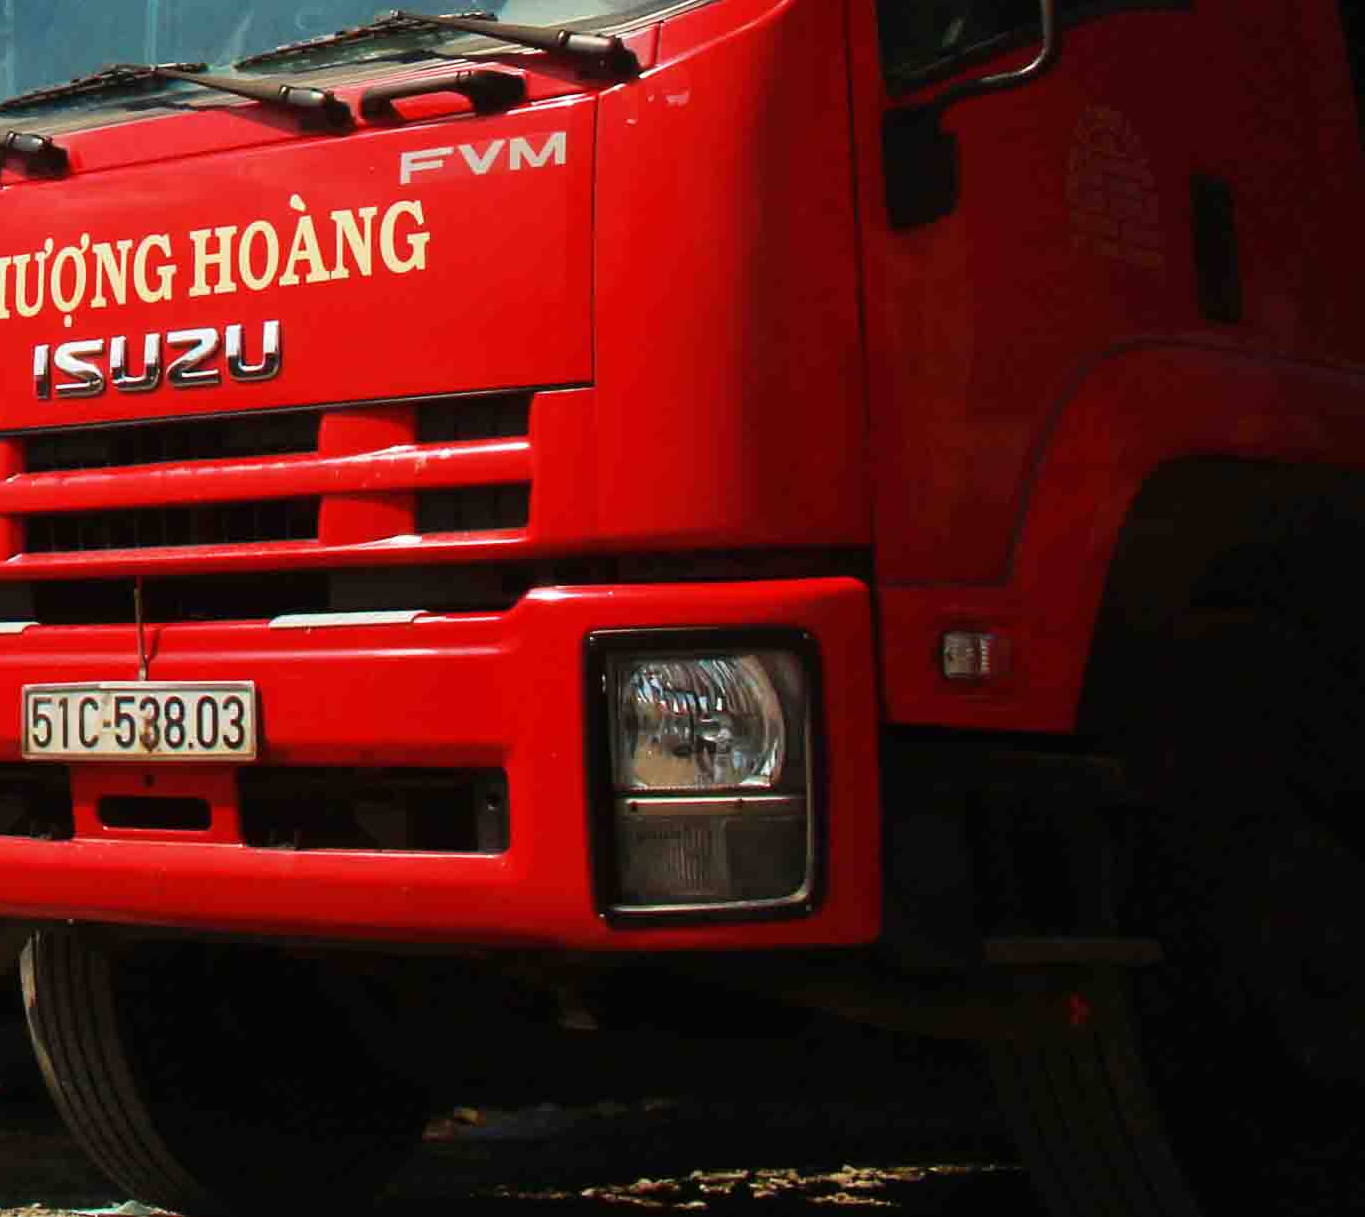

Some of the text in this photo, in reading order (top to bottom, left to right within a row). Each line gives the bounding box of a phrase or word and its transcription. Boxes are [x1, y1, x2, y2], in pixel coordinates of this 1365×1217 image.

[400, 132, 567, 185] FVM
[189, 194, 431, 297] HOÀNG
[32, 320, 282, 400] ISUZU
[32, 695, 245, 751] 51C-538.03
